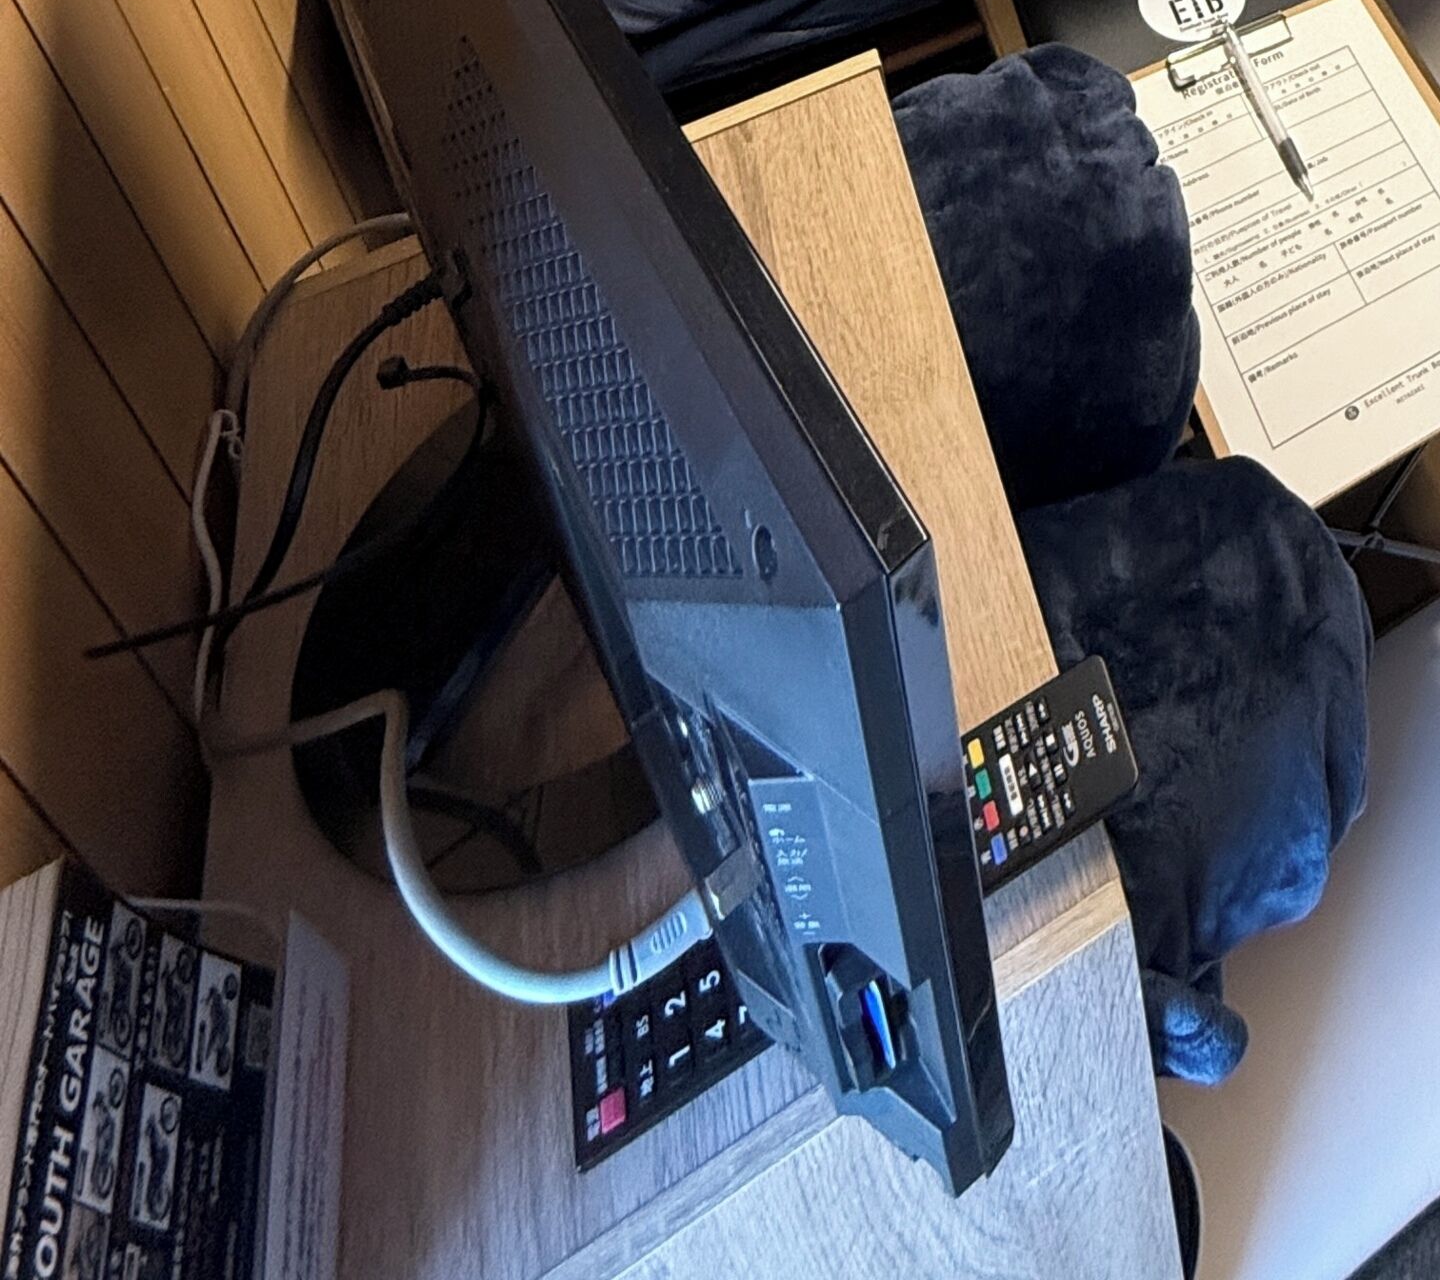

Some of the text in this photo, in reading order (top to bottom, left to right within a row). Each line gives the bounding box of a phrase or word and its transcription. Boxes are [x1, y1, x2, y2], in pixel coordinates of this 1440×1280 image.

[1181, 50, 1284, 99] Registrat Form
[1270, 204, 1292, 216] Travel
[1278, 230, 1302, 245] people
[1224, 276, 1240, 287] 大人
[1288, 301, 1307, 316] place
[1363, 381, 1405, 408] Excellent
[1406, 367, 1429, 383] Trunk
[1074, 710, 1097, 759] AQUOS
[1092, 694, 1117, 754] SHARP
[699, 970, 721, 992] 5
[664, 990, 687, 1017] 2
[636, 1014, 650, 1039] BS
[705, 1019, 726, 1039] 4
[668, 1044, 691, 1068] 1
[34, 1124, 75, 1280] OUTH
[60, 916, 104, 1113] GARAGE
